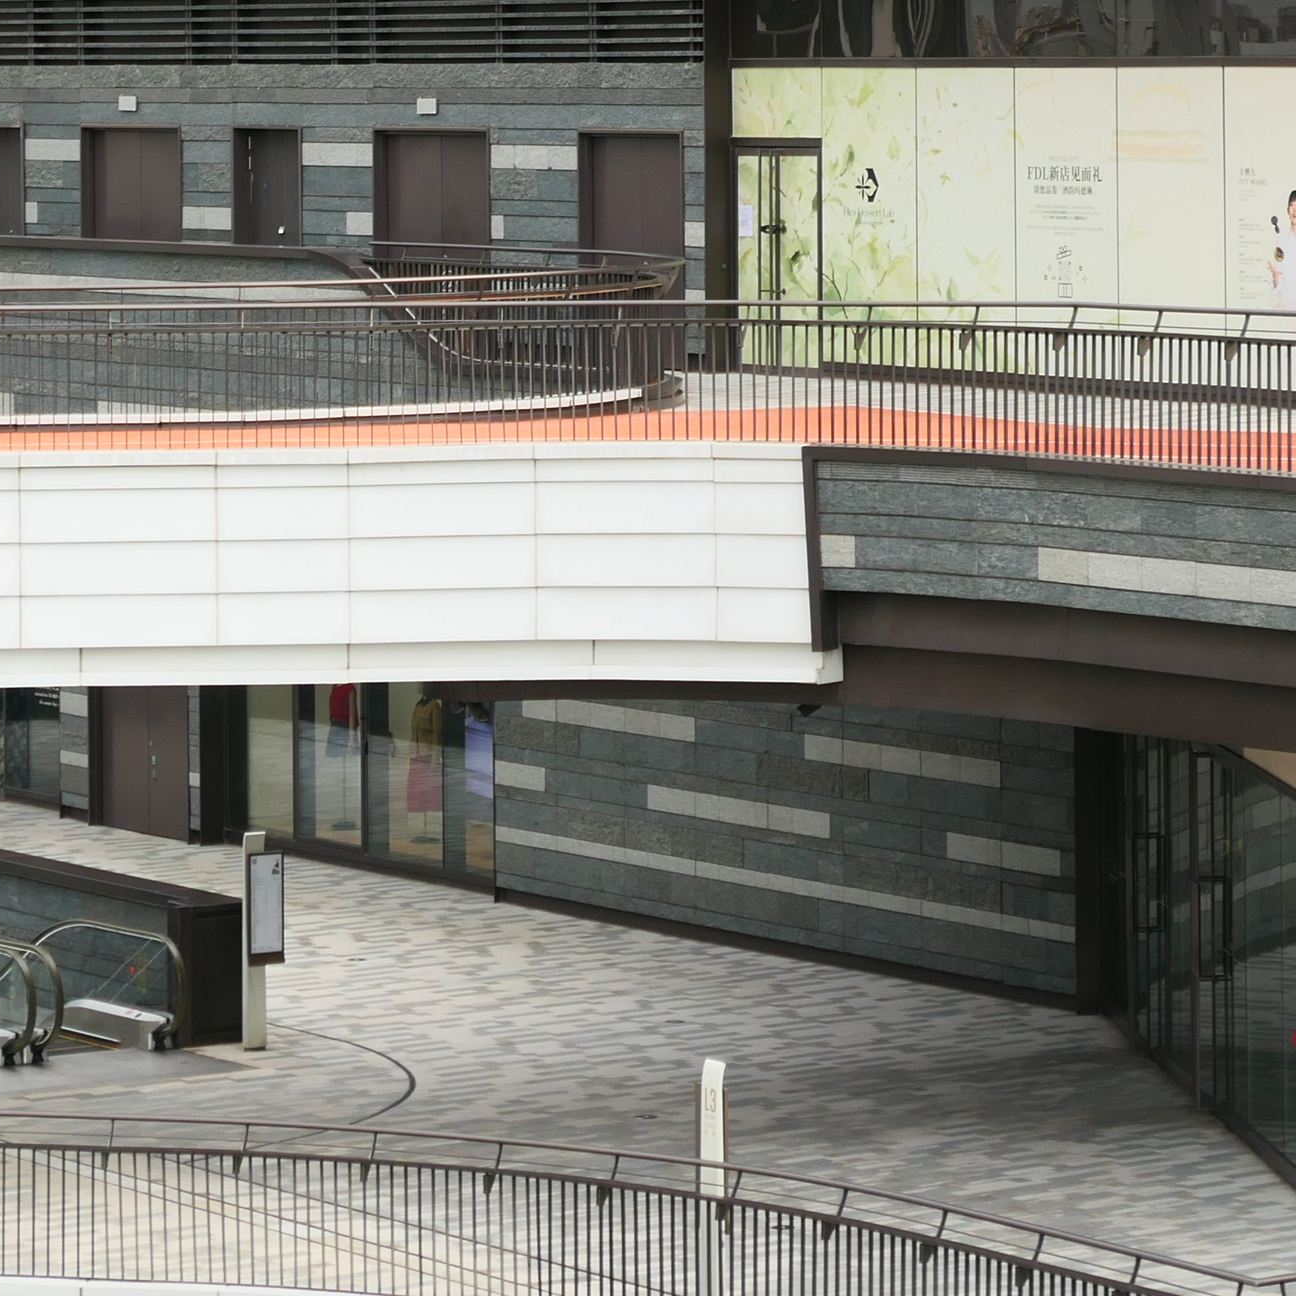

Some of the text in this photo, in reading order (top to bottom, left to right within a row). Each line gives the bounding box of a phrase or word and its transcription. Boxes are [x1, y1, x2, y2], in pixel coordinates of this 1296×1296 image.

[1027, 165, 1103, 182] FDL新店见面礼
[704, 1087, 717, 1113] L3
